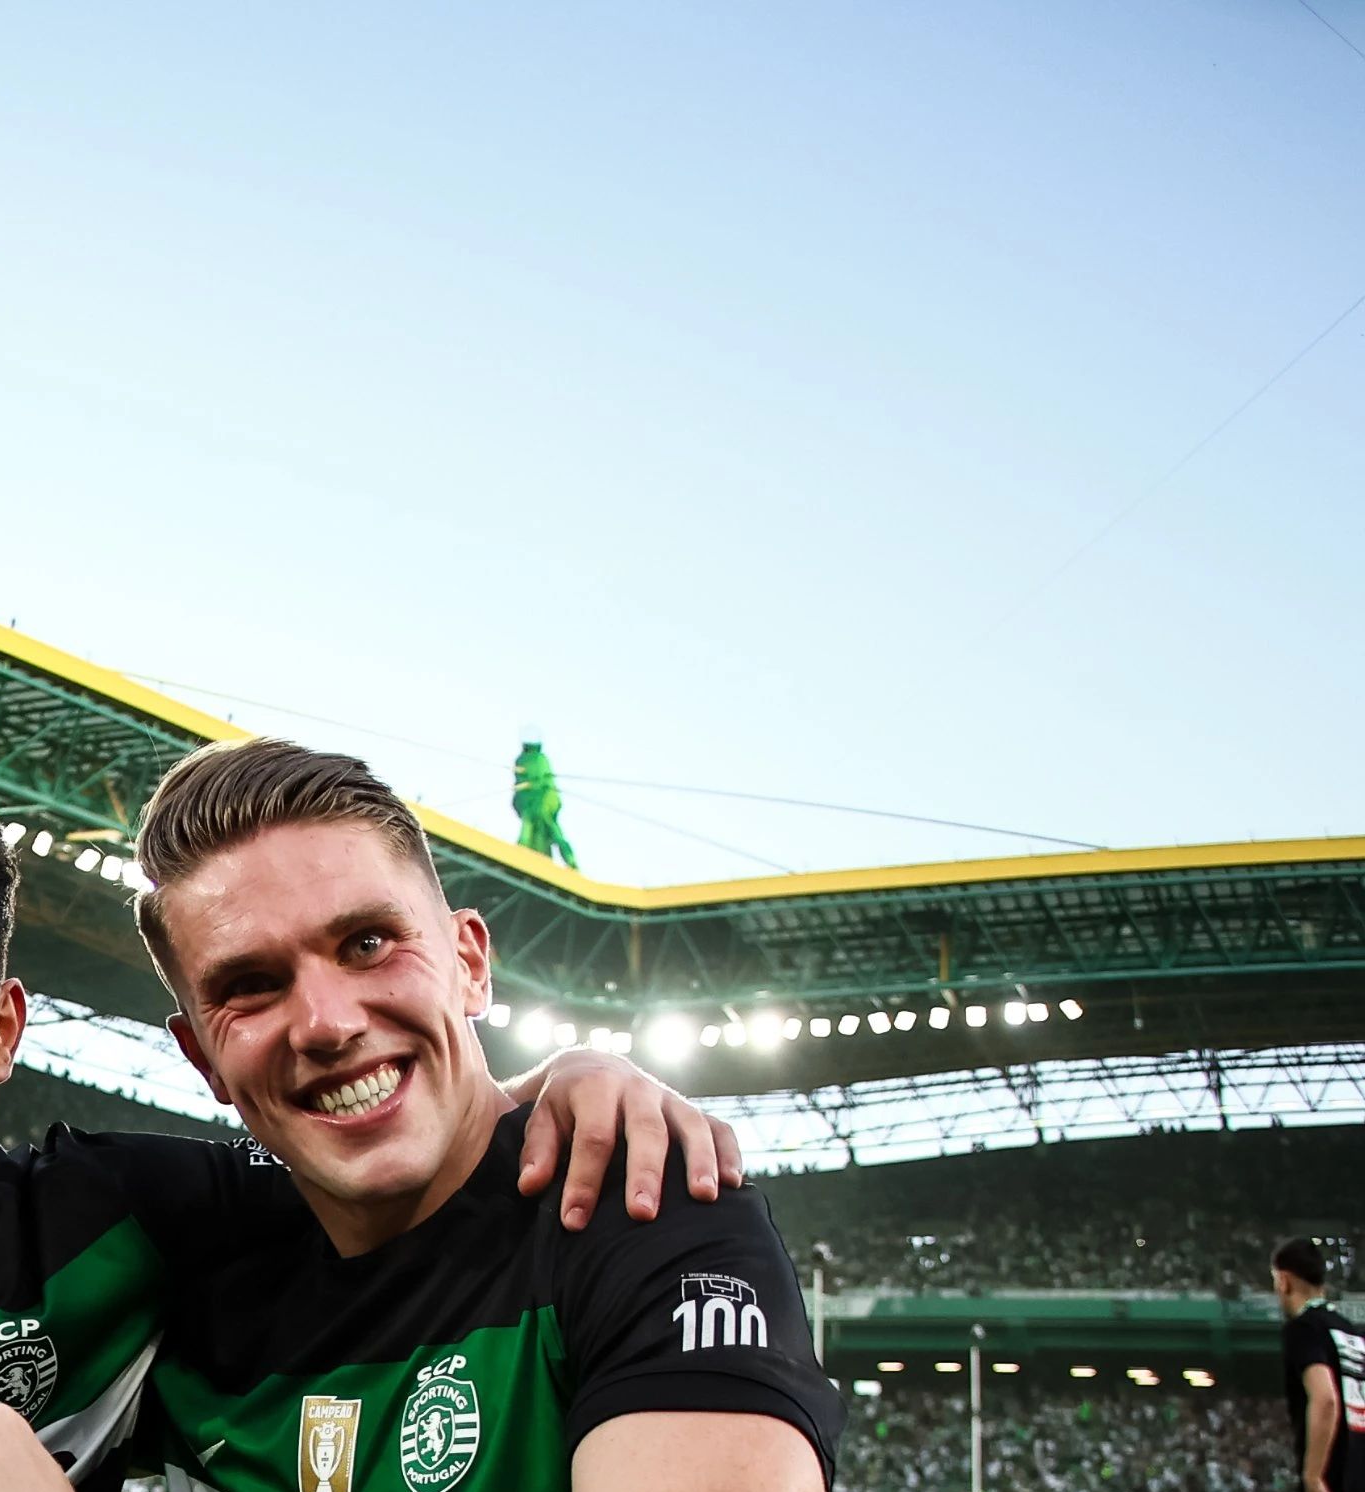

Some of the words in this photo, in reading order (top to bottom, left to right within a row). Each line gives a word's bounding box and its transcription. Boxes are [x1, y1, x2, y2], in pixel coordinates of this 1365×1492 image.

[416, 1354, 467, 1388] SCP
[407, 1385, 468, 1422] SPORTING
[407, 1460, 466, 1485] PORTUGAL
